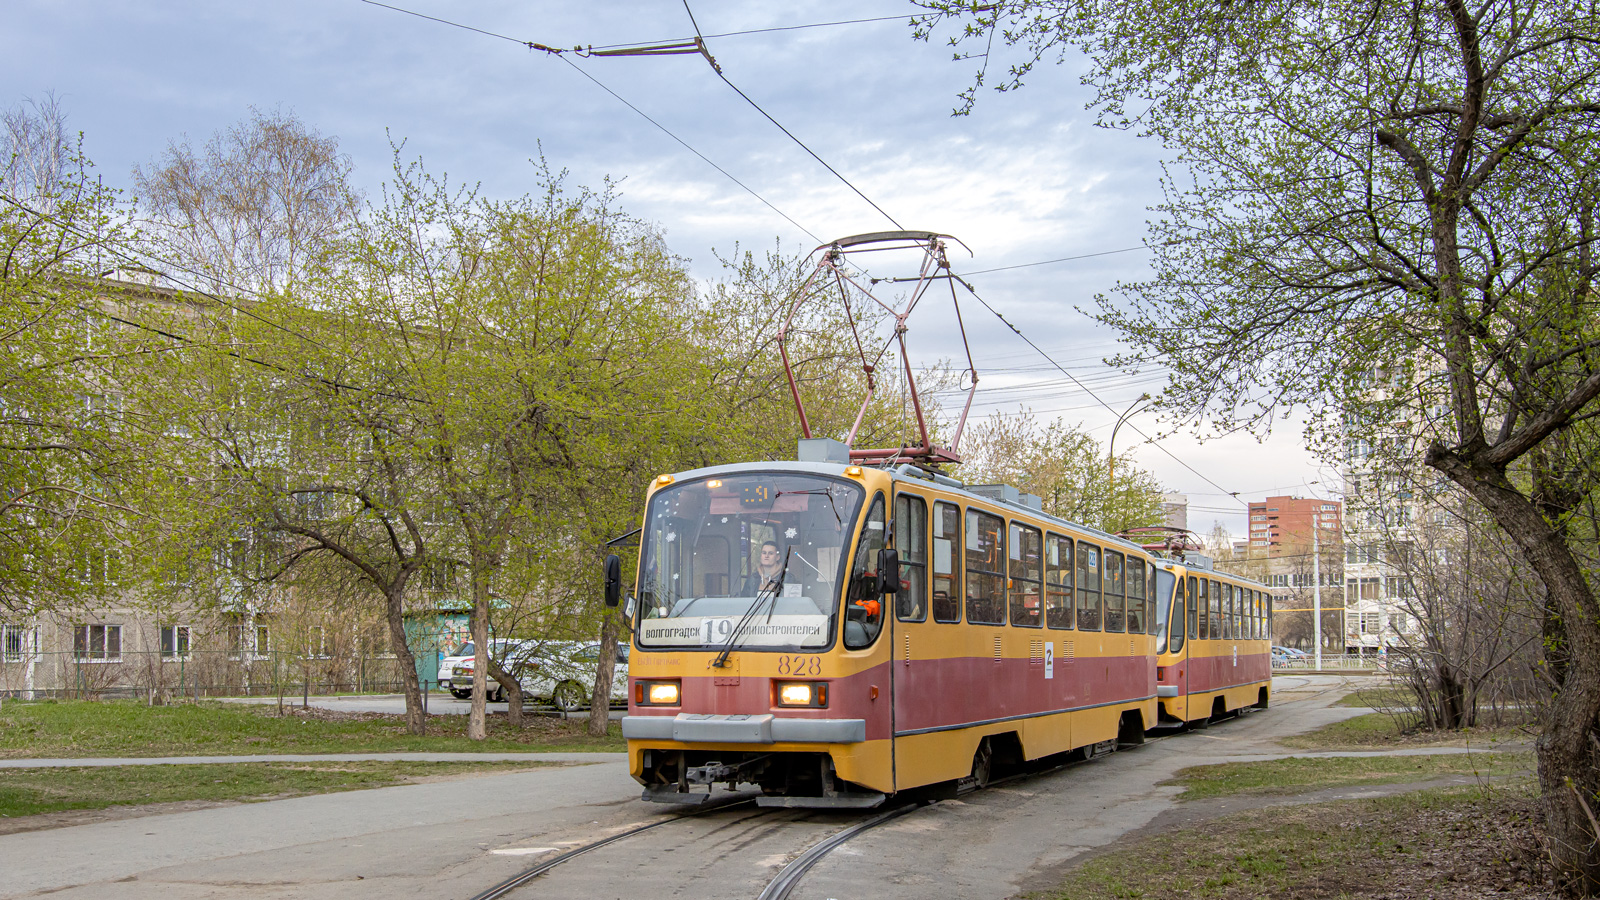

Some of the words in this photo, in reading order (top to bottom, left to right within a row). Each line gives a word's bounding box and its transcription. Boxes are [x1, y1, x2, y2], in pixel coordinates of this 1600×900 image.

[704, 619, 733, 644] 19
[778, 655, 822, 676] 828
[1046, 649, 1052, 666] 2
